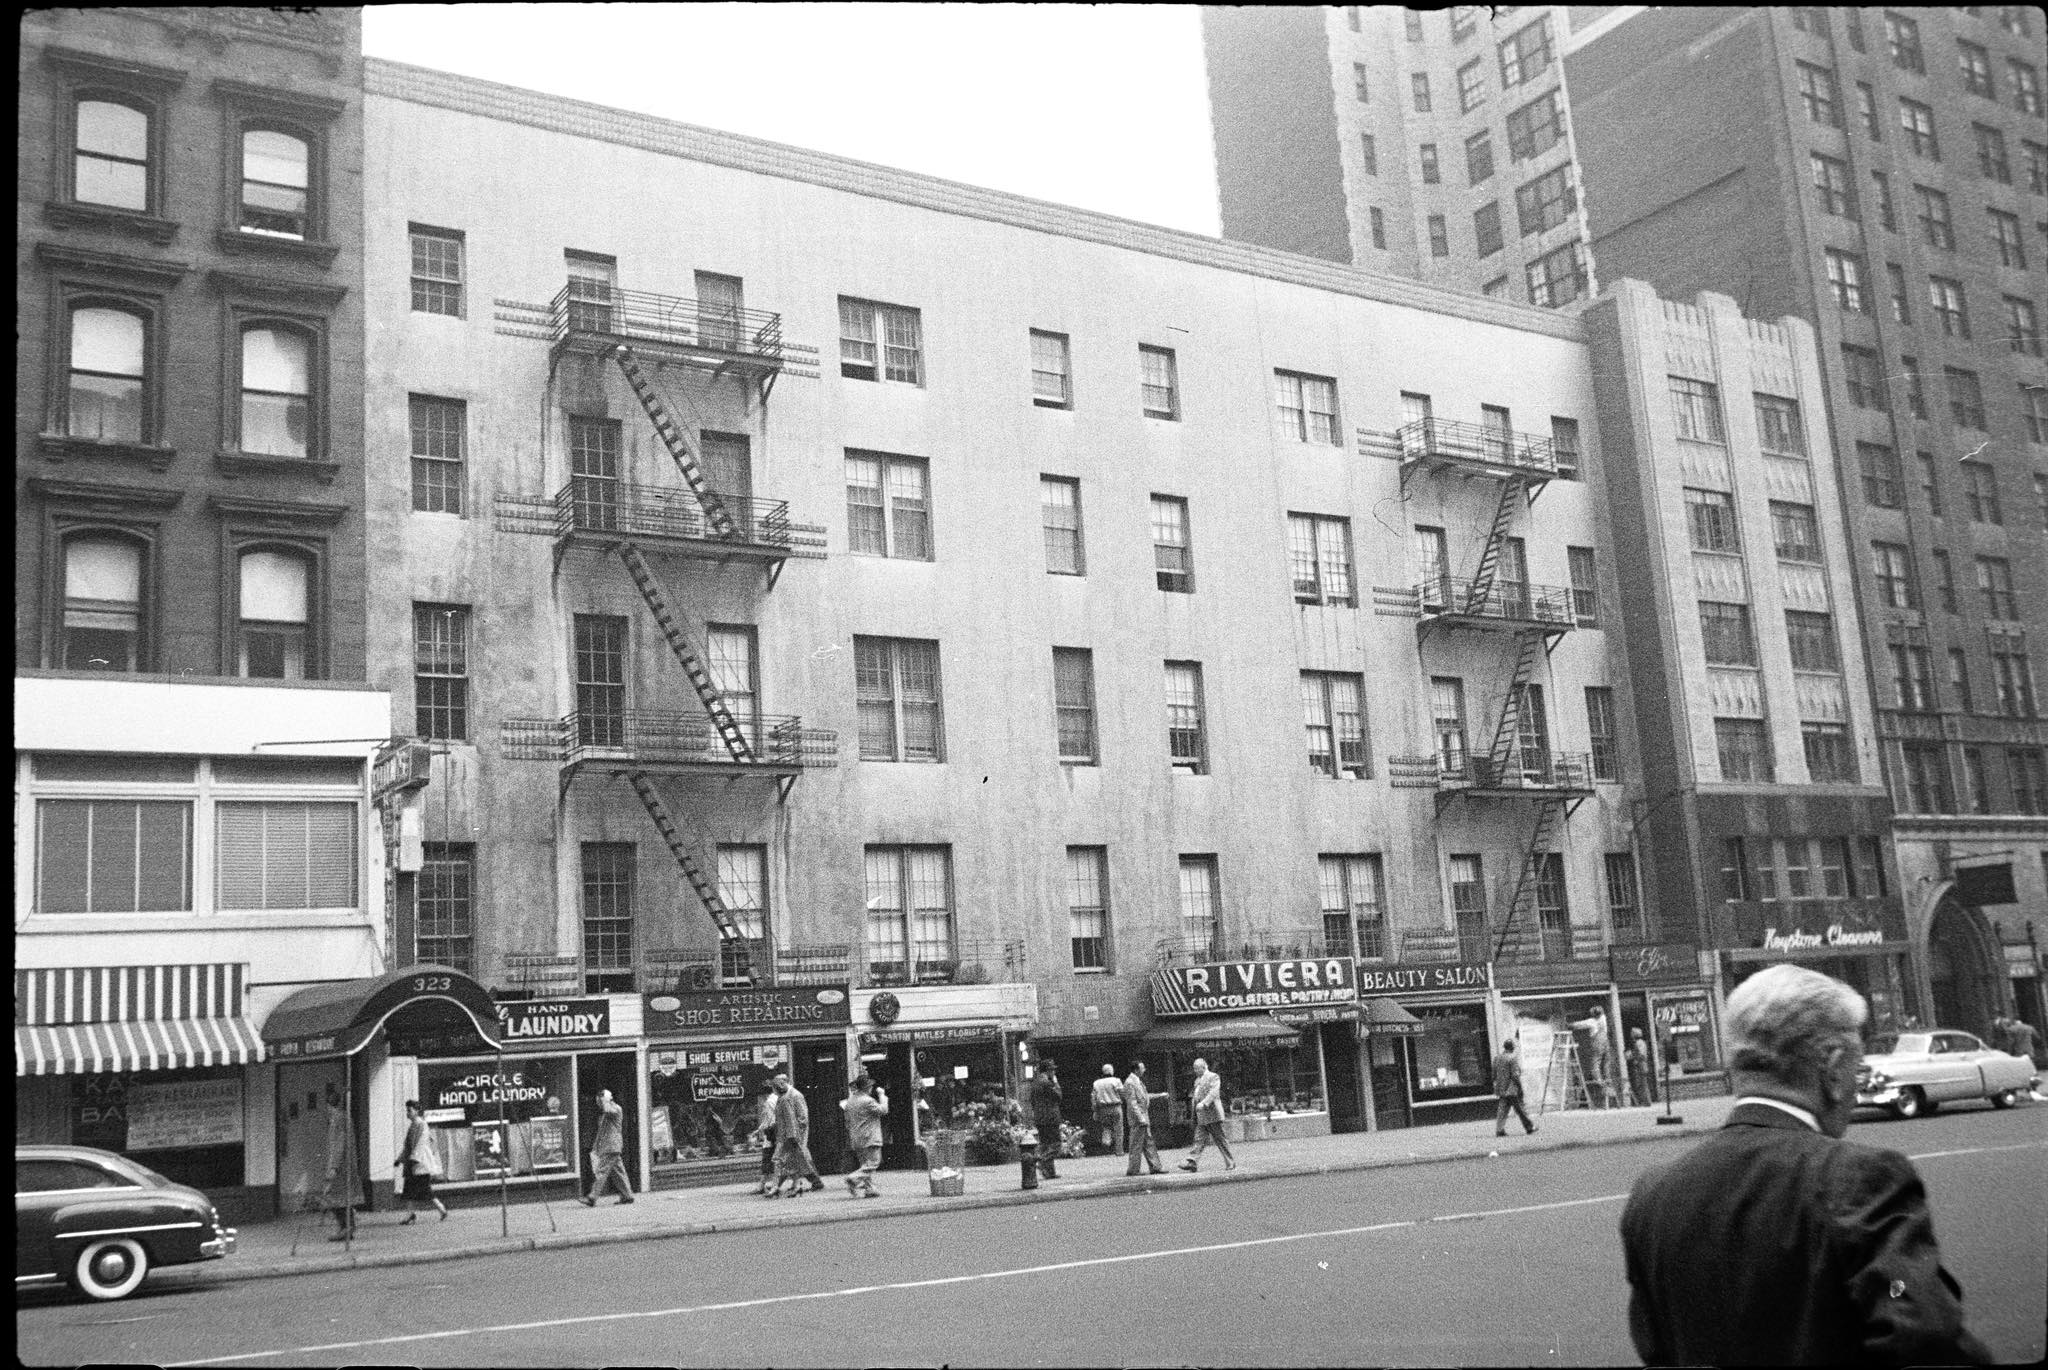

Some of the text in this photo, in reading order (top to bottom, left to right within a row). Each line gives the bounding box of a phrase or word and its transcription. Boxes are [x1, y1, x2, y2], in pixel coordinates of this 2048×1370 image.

[1827, 924, 1883, 945] Cleaners
[413, 976, 451, 992] 323
[1186, 960, 1344, 994] RIVIERA
[1363, 966, 1486, 989] BEAUTY SALON
[720, 993, 782, 1006] ARTISTIC
[527, 1004, 569, 1014] HAND
[674, 1005, 823, 1026] SHOE REPAIRING
[507, 1013, 604, 1037] LAUNDRY
[947, 1027, 981, 1038] FLORIST
[689, 1050, 750, 1064] SHOE SERVICE
[465, 1072, 523, 1089] CIRCLE
[439, 1086, 546, 1106] HAND LAUNDRY
[698, 1087, 740, 1096] REPAIRING
